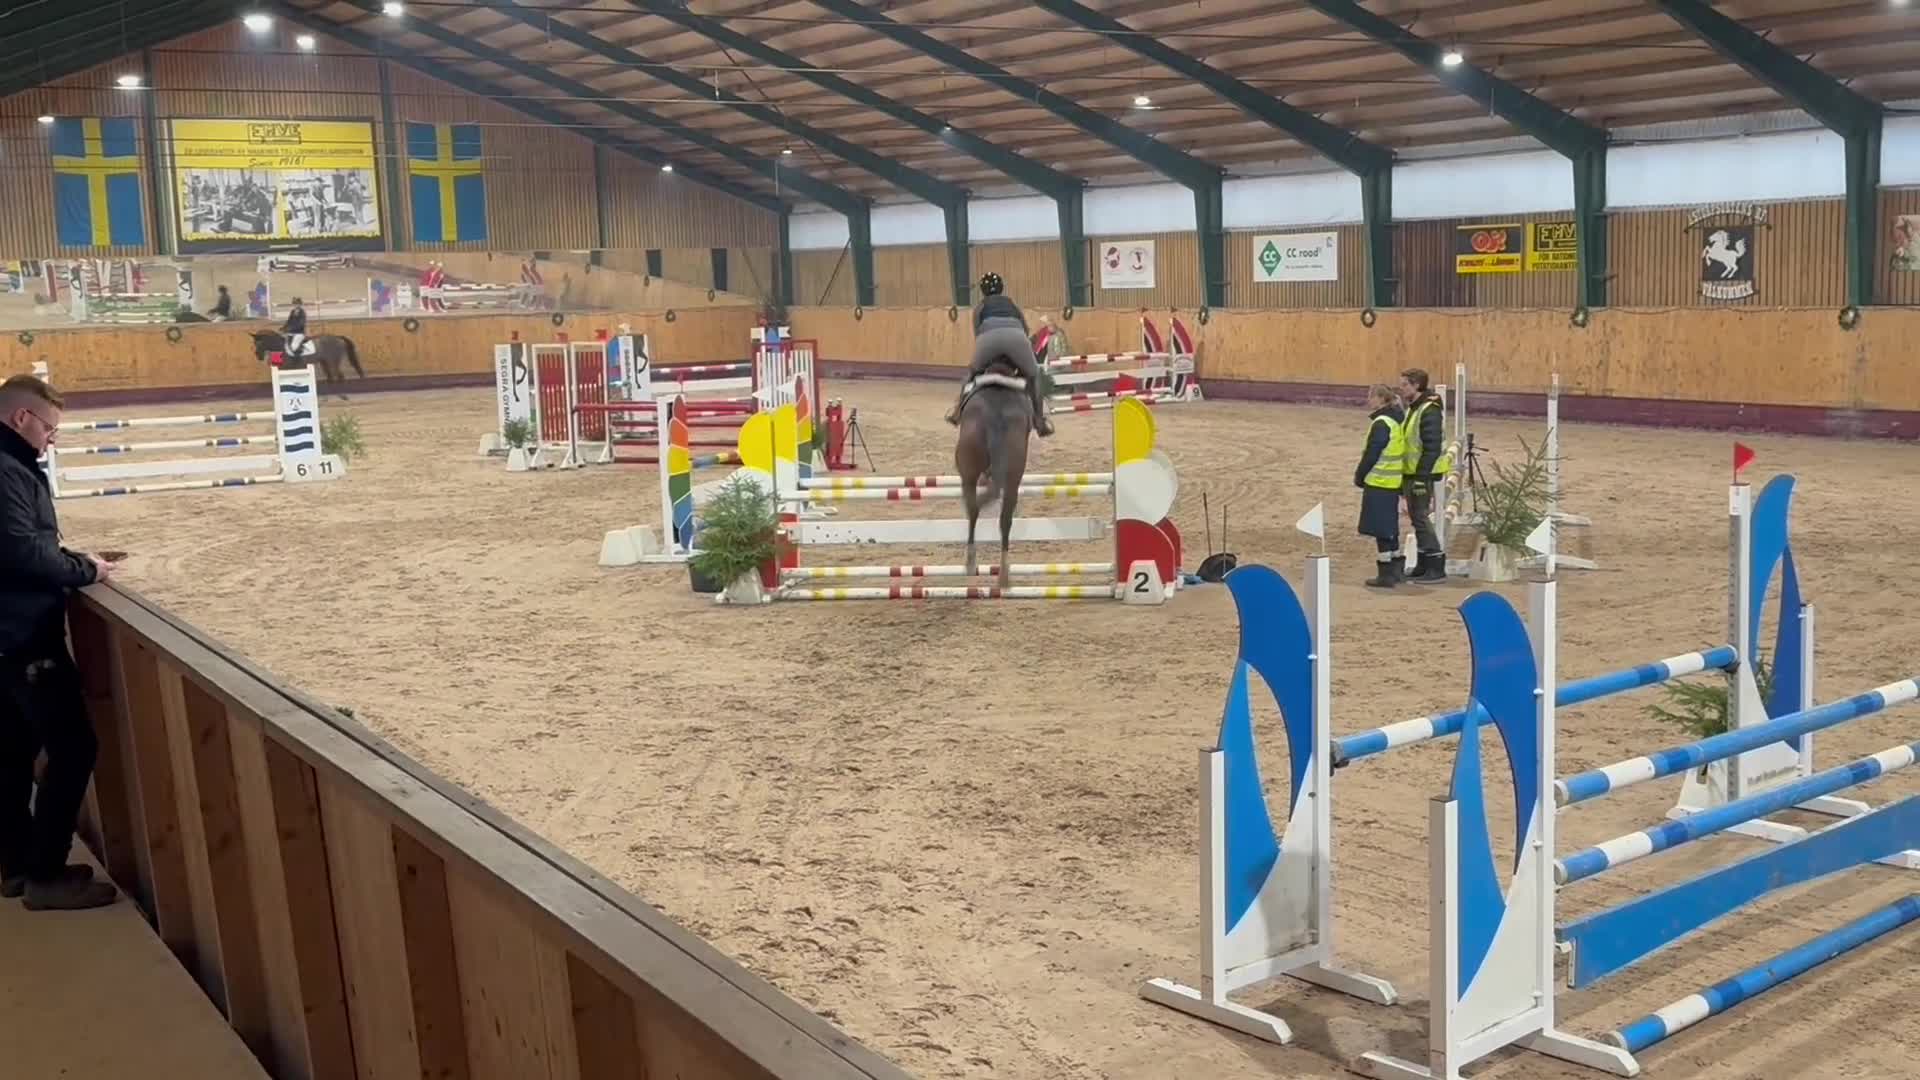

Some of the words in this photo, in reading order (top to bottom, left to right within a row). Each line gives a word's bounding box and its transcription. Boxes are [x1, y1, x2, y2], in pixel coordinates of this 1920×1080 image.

[1286, 247, 1297, 258] CC
[296, 463, 307, 477] 6
[319, 461, 333, 475] 11
[1134, 572, 1149, 593] 2
